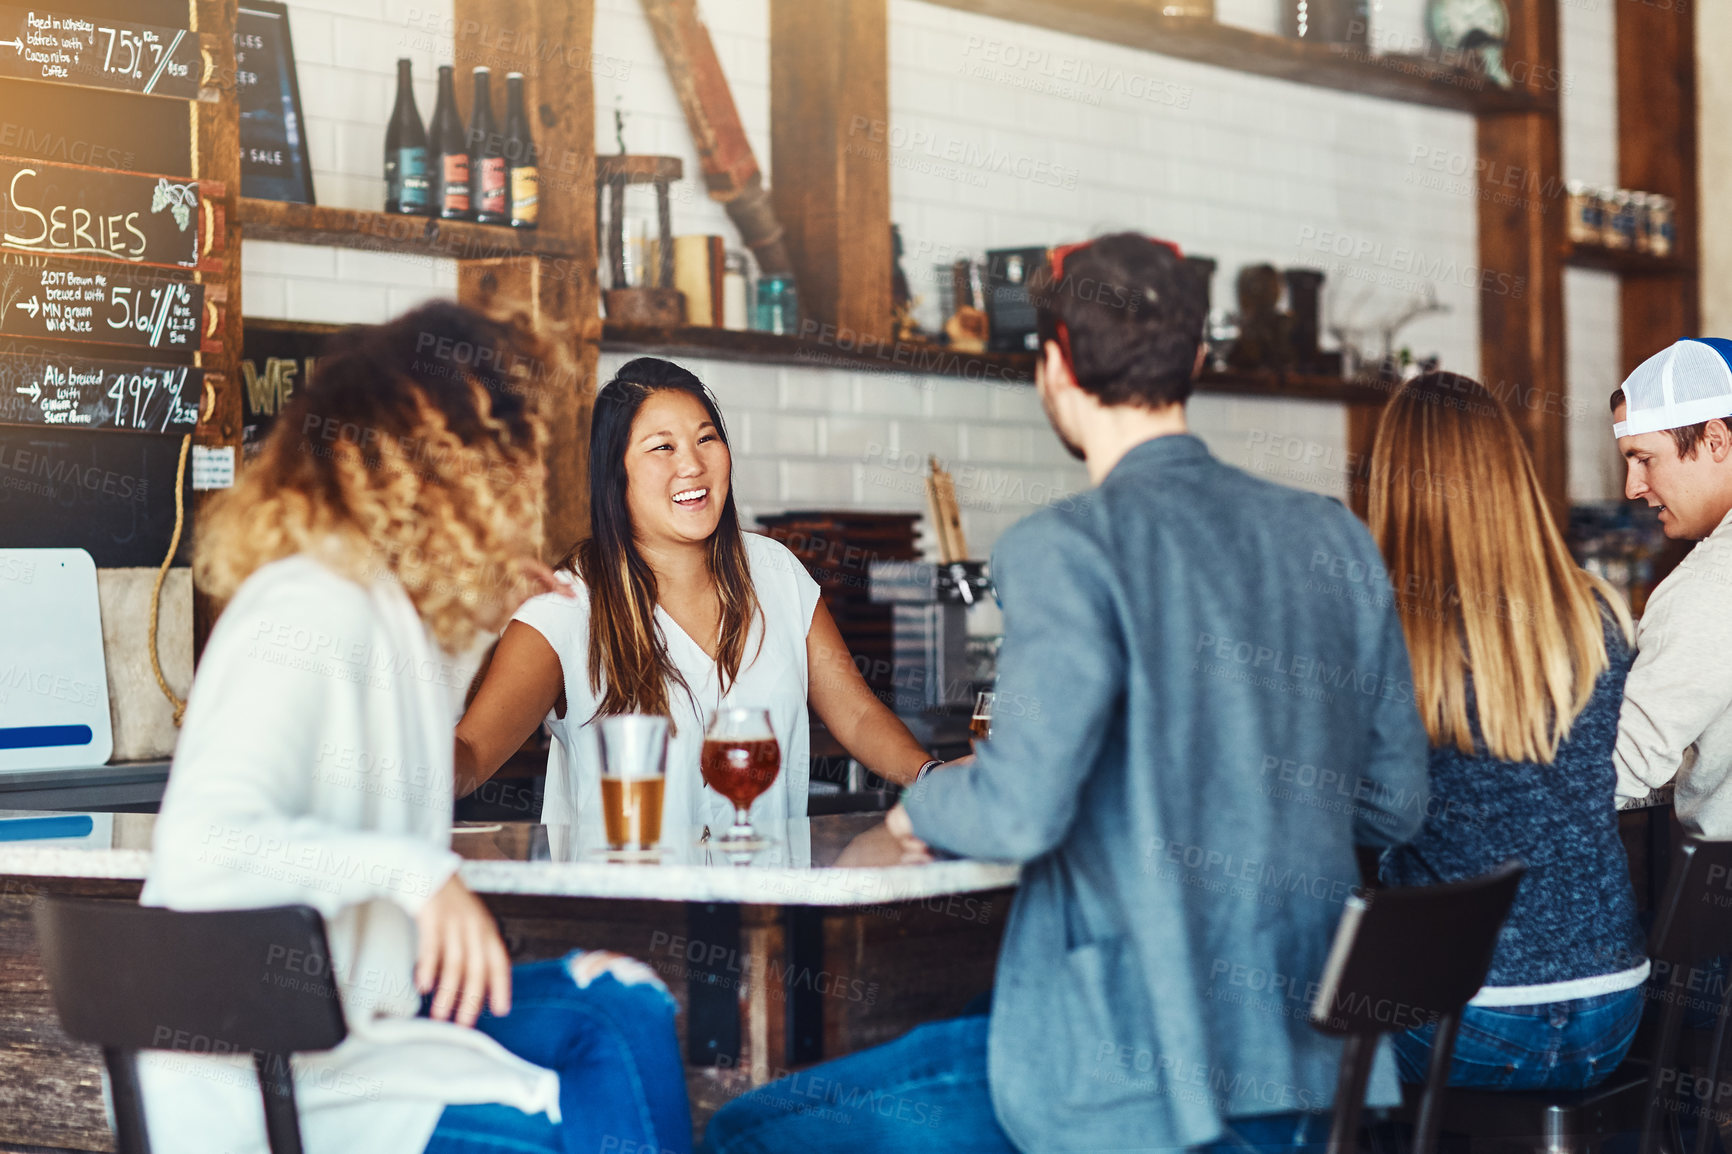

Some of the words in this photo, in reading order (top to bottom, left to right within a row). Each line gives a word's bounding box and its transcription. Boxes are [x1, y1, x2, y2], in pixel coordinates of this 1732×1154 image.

[62, 37, 83, 50] with
[41, 270, 66, 286] 2017
[46, 286, 82, 302] brewed
[84, 288, 105, 302] with
[42, 302, 62, 318] MN
[44, 364, 66, 387] Ale
[68, 366, 104, 386] brewed
[56, 387, 81, 400] with
